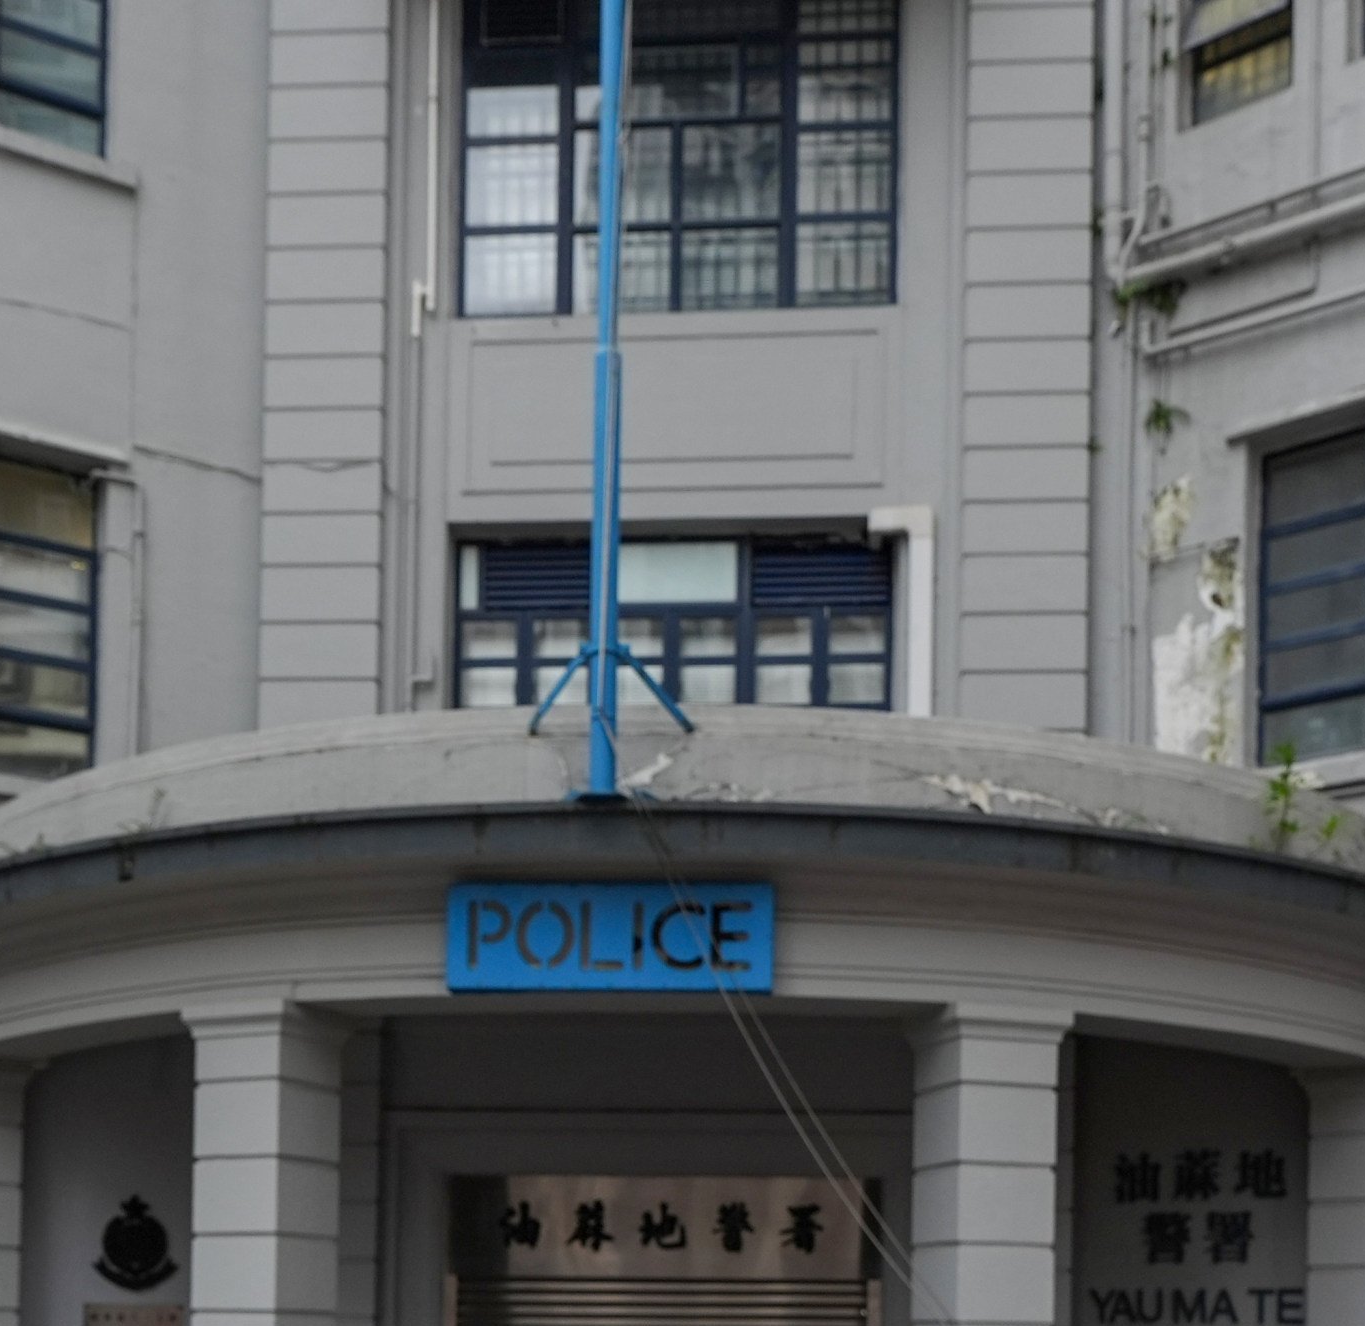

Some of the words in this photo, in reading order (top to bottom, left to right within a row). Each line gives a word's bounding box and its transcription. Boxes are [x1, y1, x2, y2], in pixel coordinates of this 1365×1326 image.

[466, 900, 753, 971] POLICE
[1143, 1211, 1252, 1265] 警署
[1089, 1287, 1163, 1324] YAU
[1171, 1287, 1238, 1325] MA
[1247, 1287, 1305, 1325] TE
